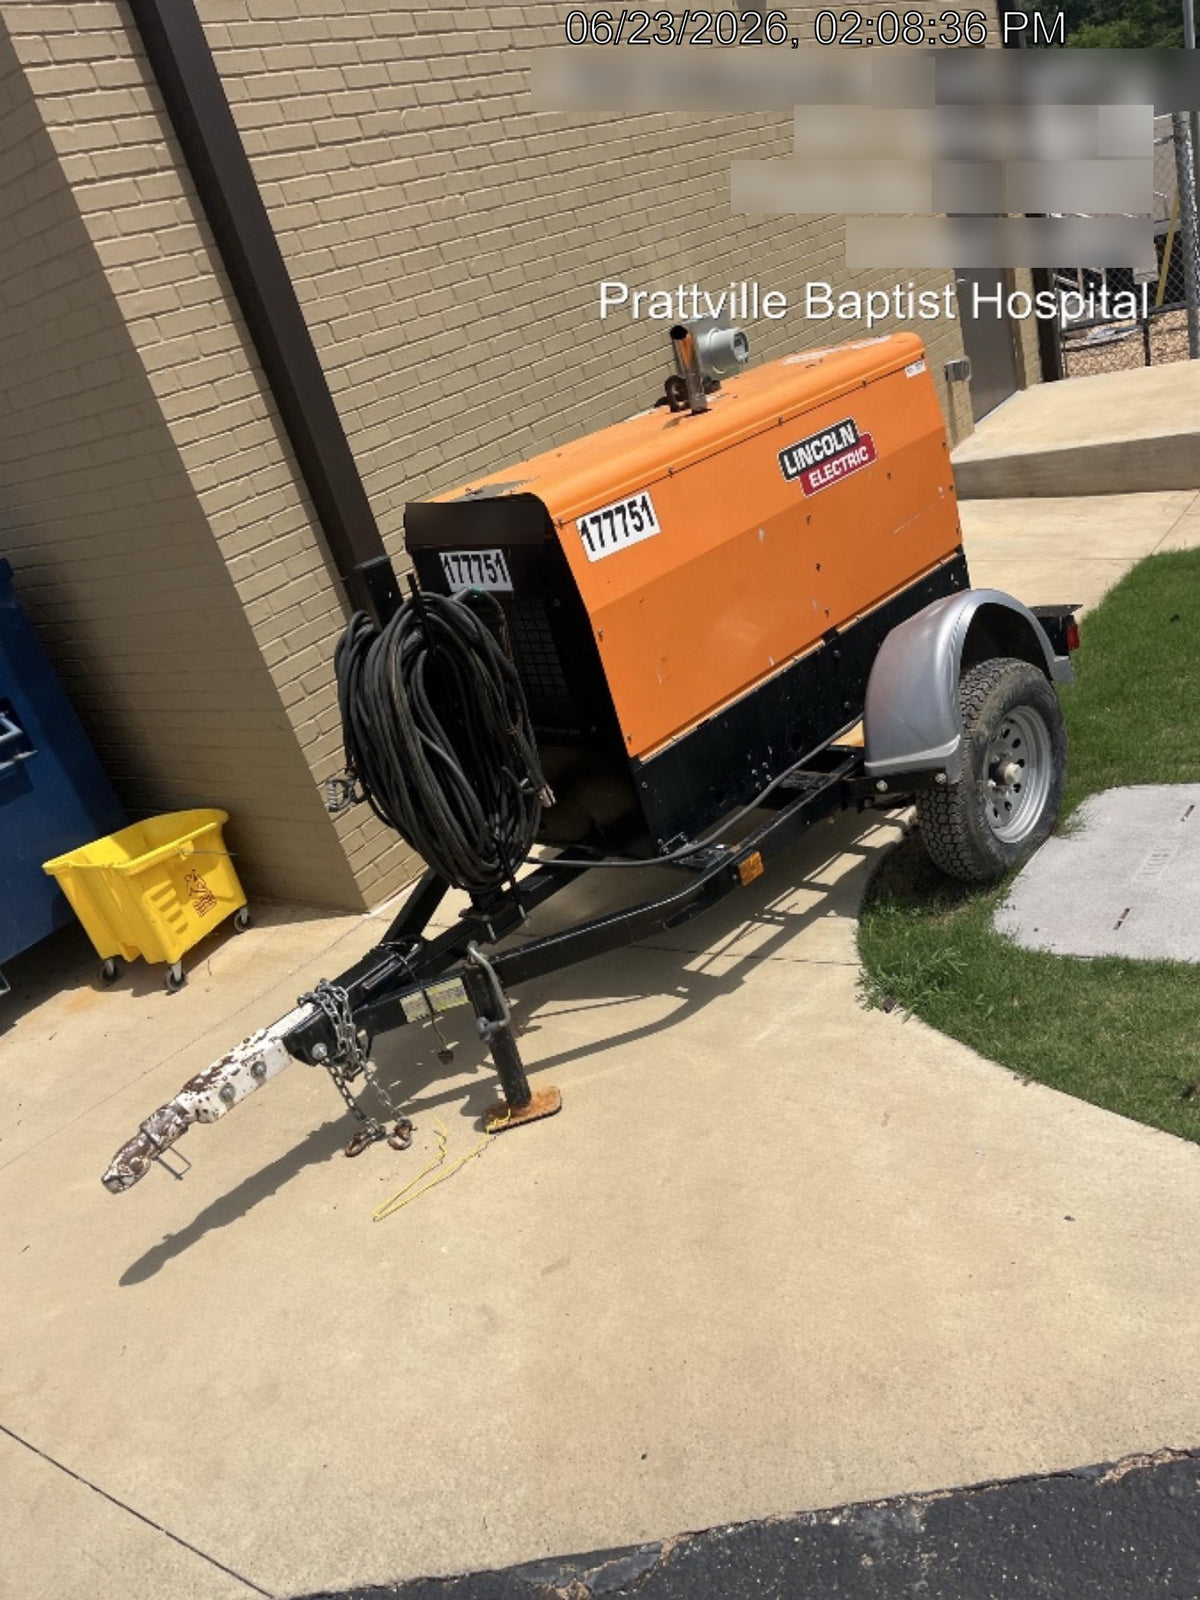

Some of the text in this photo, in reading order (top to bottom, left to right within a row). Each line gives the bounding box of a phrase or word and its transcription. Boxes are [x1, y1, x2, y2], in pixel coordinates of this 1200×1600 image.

[783, 423, 856, 475] LINCOLN
[808, 446, 869, 488] ELECTRIC
[580, 495, 654, 552] 177751
[443, 552, 508, 584] 177751
